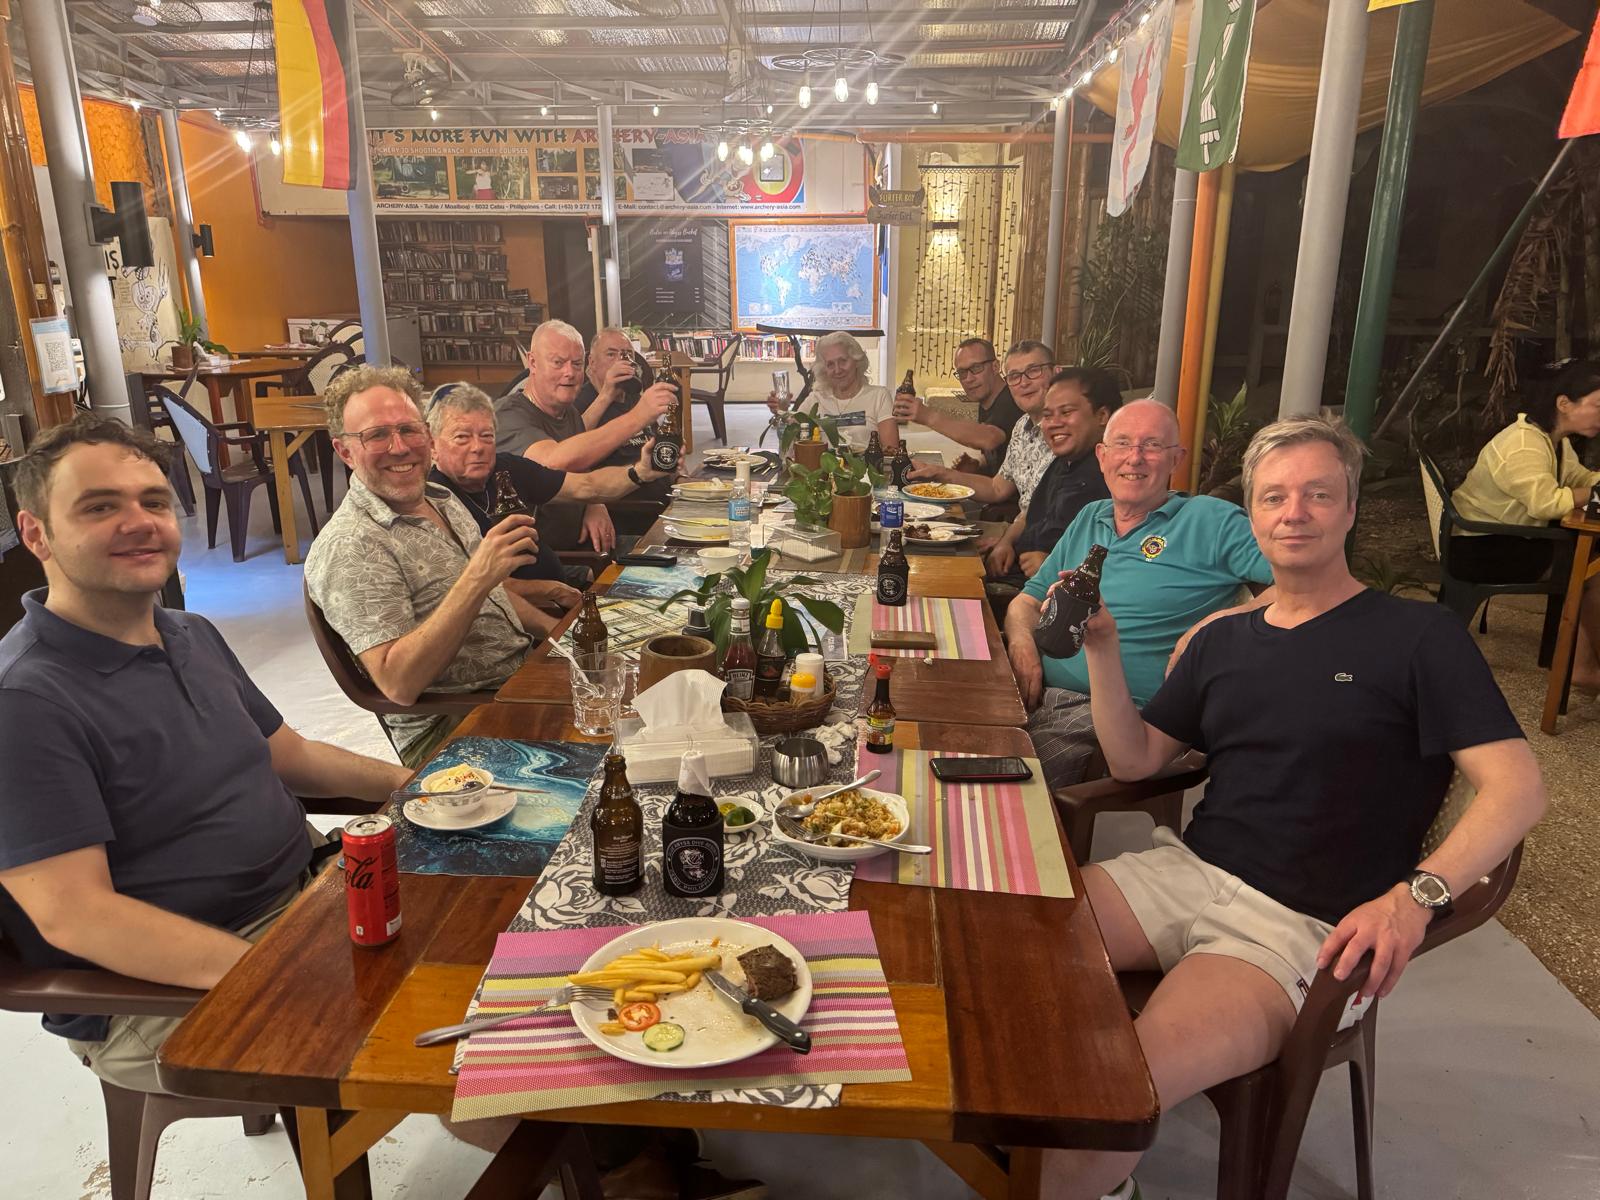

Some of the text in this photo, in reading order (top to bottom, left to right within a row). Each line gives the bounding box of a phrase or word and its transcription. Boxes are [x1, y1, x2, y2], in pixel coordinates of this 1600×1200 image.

[411, 129, 464, 143] MORE
[470, 129, 507, 143] FUN
[513, 129, 566, 143] WITH
[572, 128, 704, 144] ARHERY-ASIA
